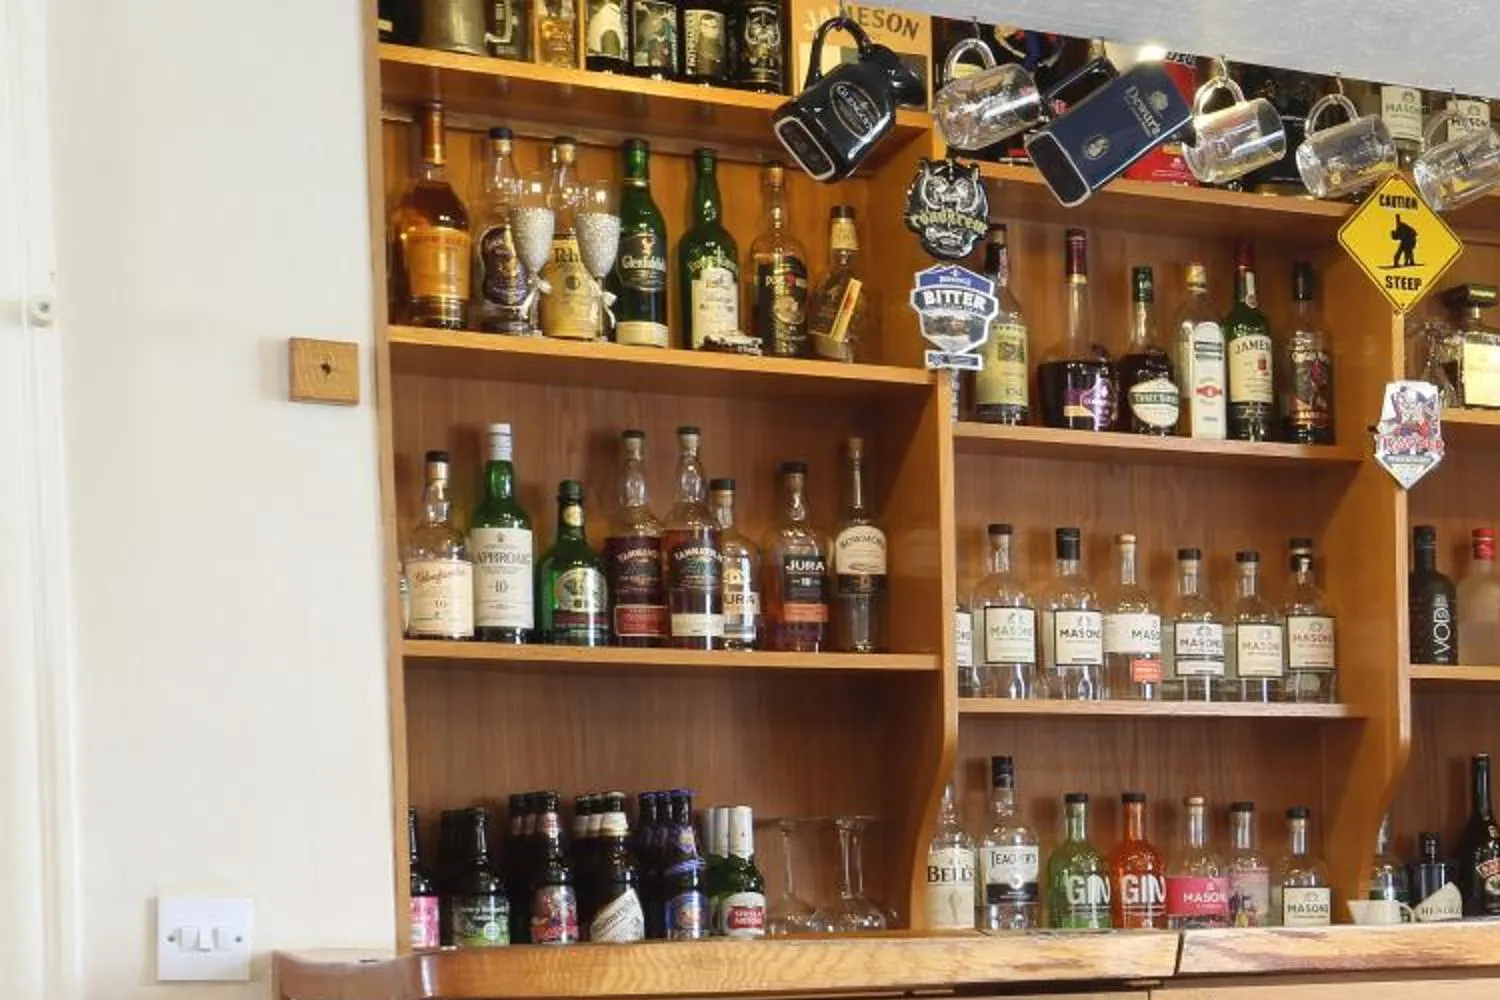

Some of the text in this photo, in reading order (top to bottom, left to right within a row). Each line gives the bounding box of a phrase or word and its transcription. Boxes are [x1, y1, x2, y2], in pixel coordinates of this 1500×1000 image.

[1378, 193, 1419, 211] CAUTION
[1385, 274, 1422, 292] STEEP
[922, 289, 987, 311] BITTER
[785, 559, 825, 573] JURA
[724, 592, 756, 605] URA
[1064, 874, 1112, 906] GIN
[1120, 873, 1167, 905] GIN
